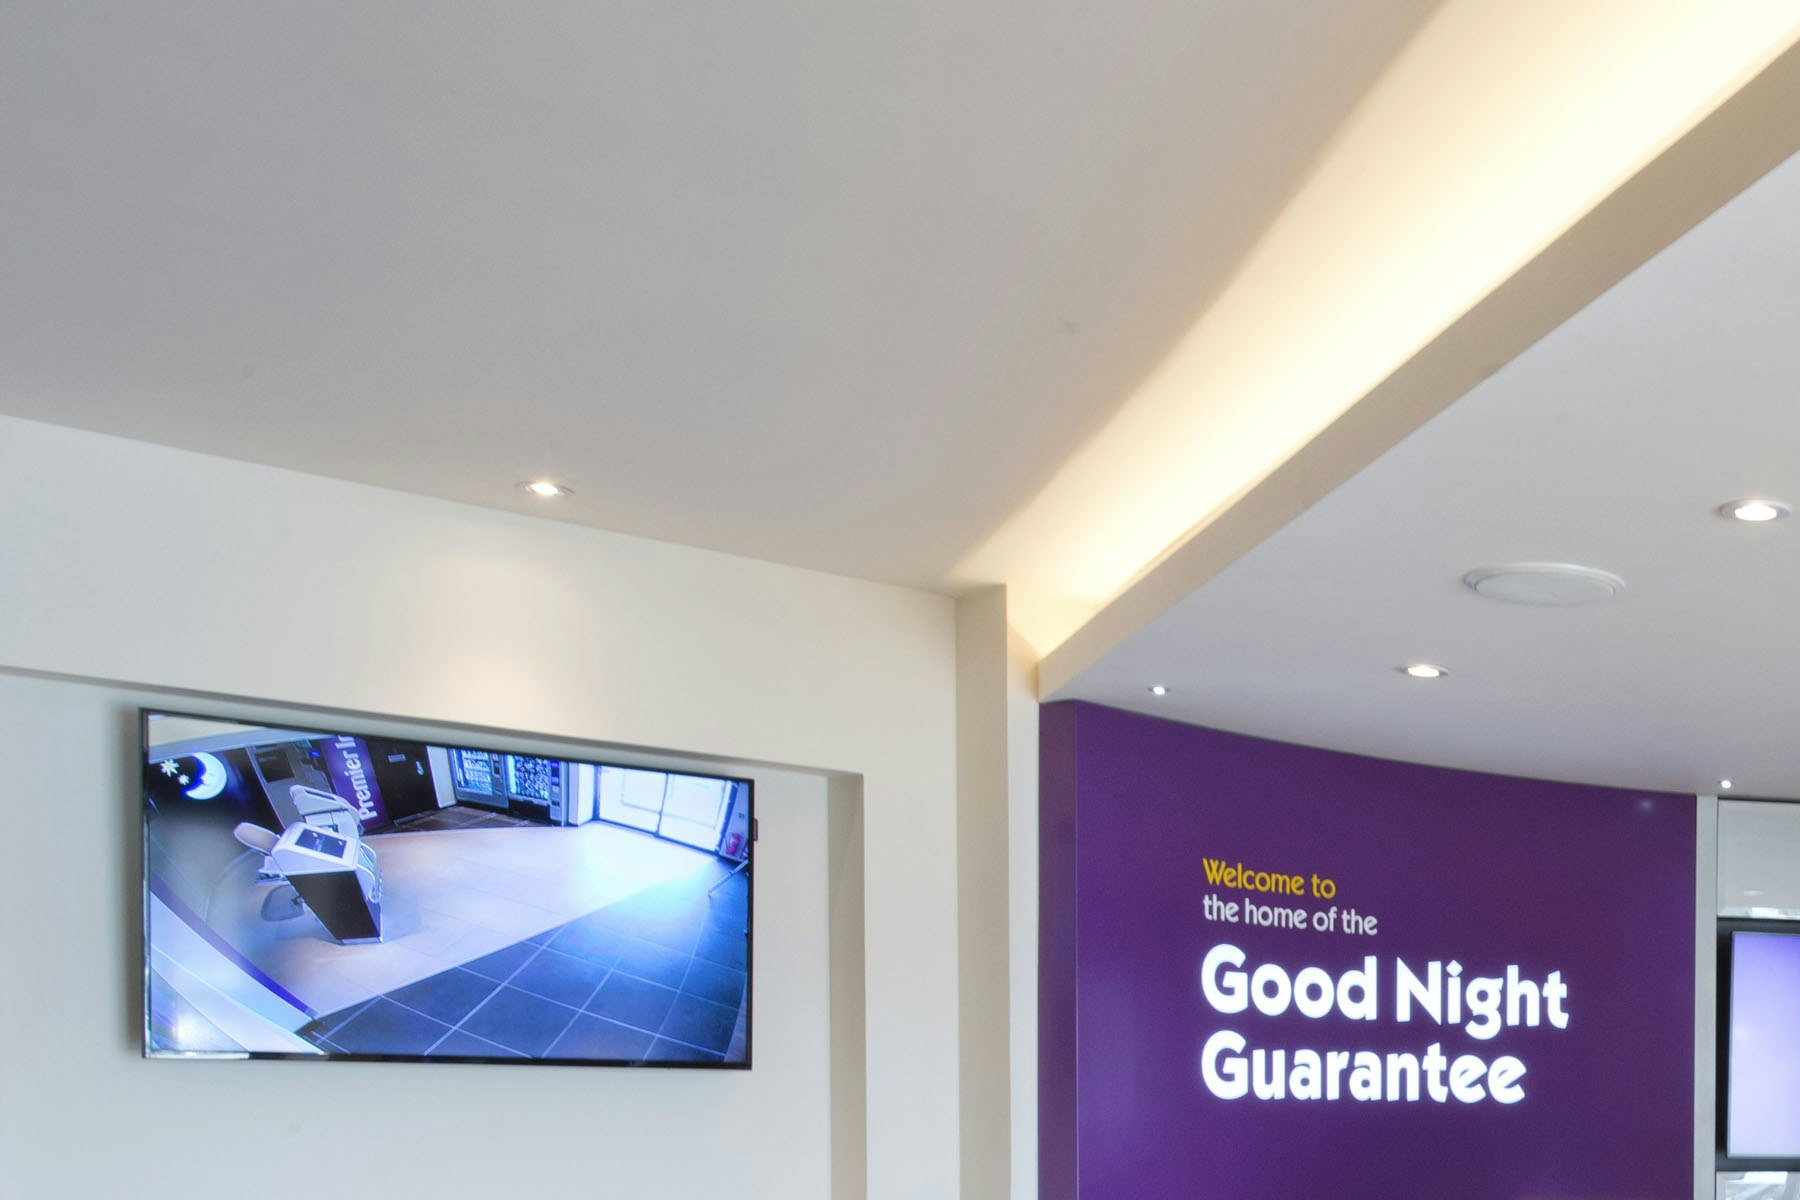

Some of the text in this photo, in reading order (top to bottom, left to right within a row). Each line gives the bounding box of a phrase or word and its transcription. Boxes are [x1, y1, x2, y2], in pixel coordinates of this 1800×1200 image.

[342, 750, 378, 820] Premier
[1203, 858, 1336, 899] Welcome to
[1203, 894, 1378, 935] the home of the
[1201, 943, 1569, 1040] Good Night
[1201, 1029, 1527, 1104] Guarantee
